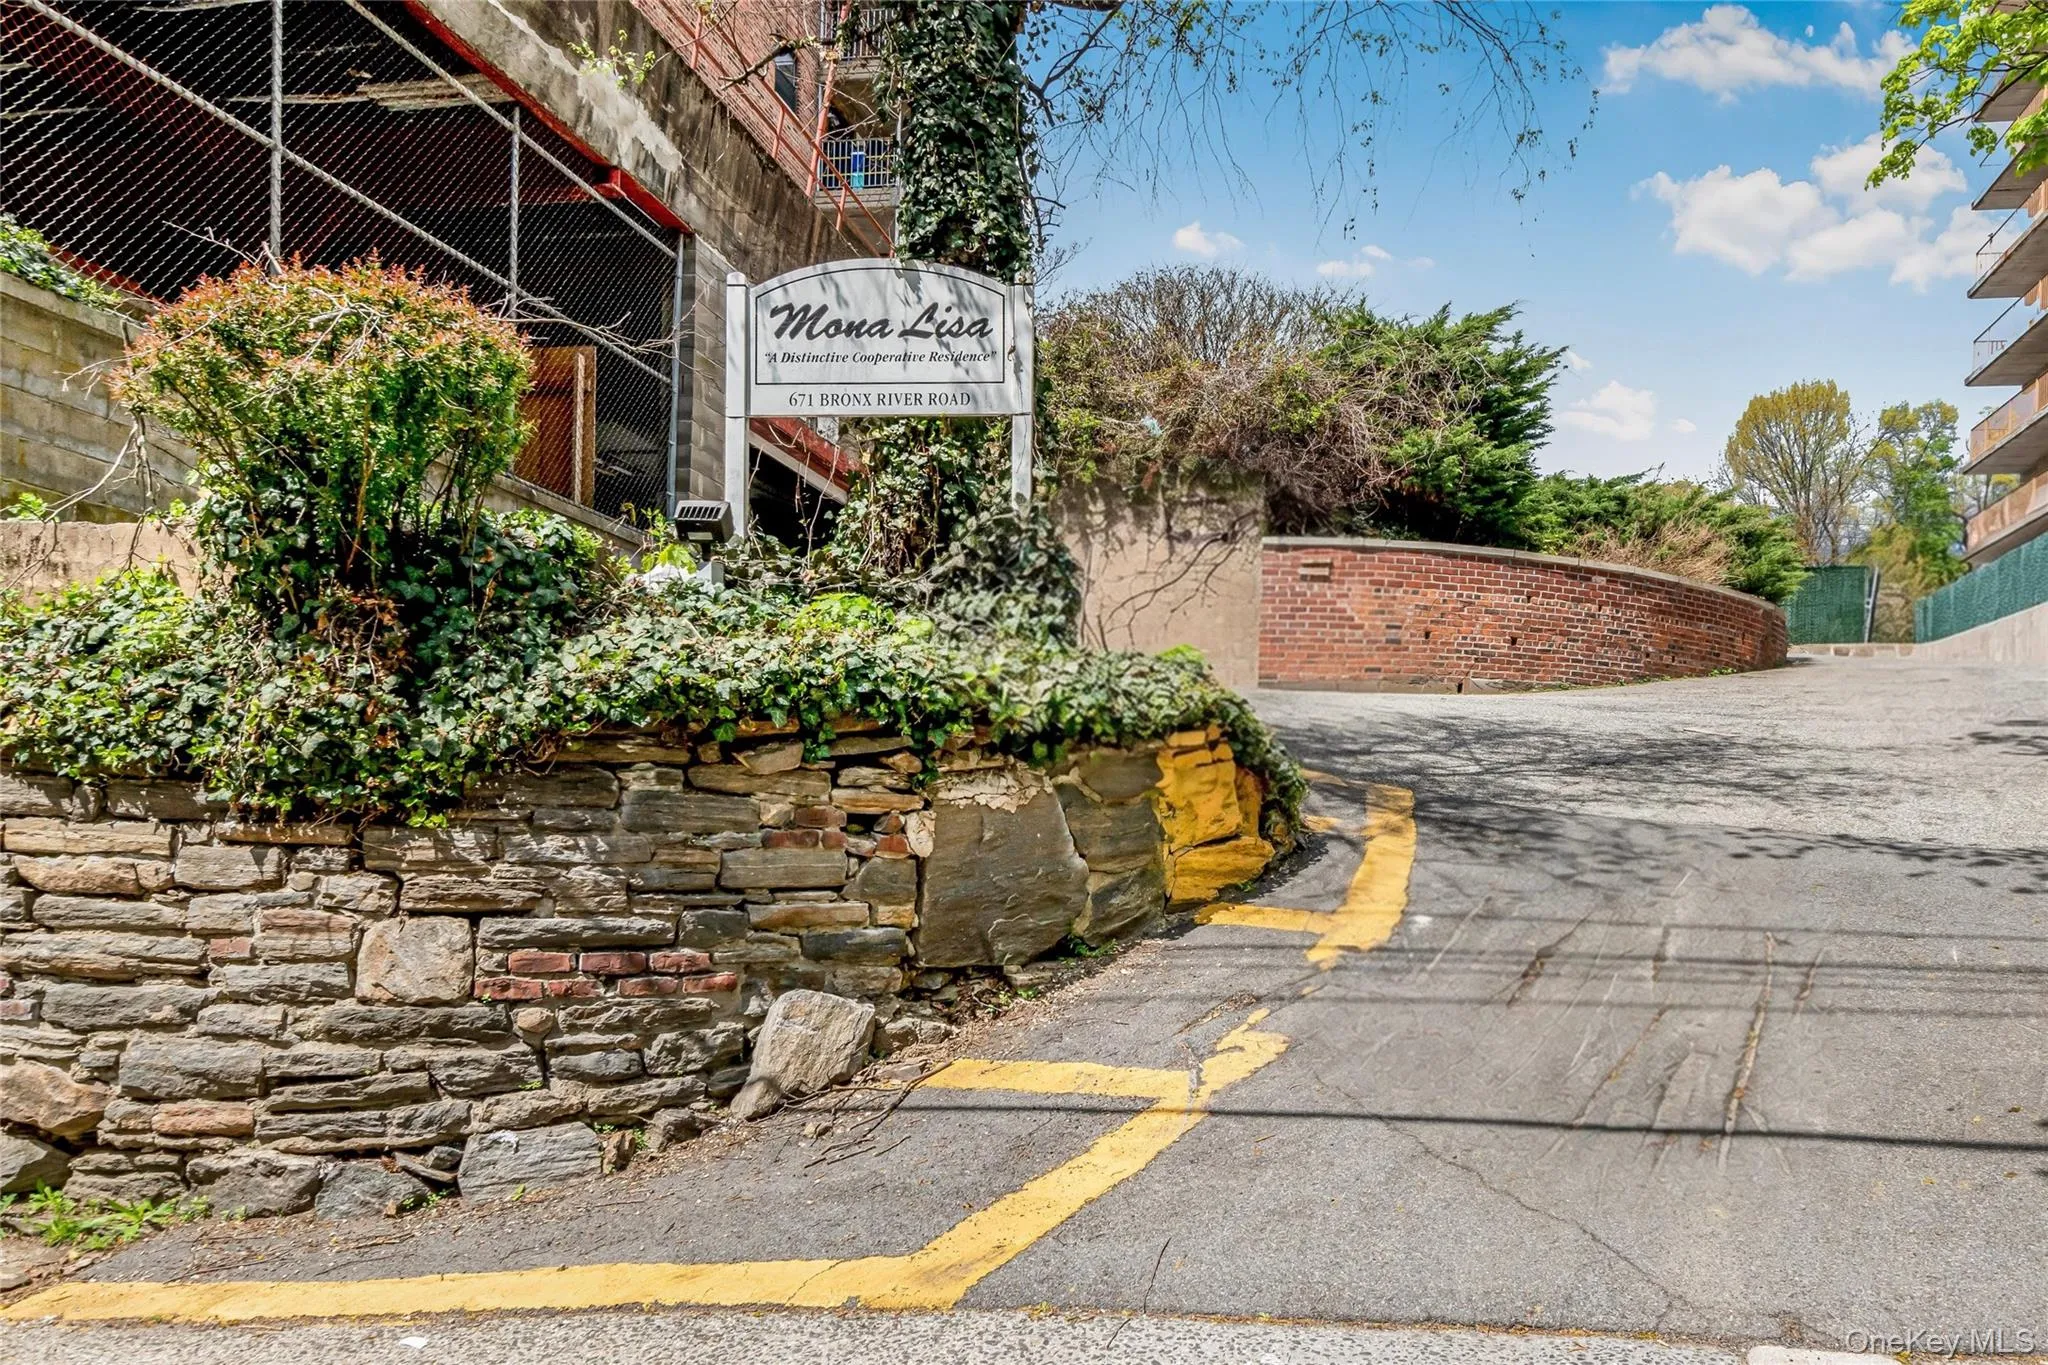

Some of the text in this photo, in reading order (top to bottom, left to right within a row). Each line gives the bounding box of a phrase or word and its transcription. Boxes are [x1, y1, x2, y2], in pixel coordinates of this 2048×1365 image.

[770, 302, 994, 341] Mona Lisa
[780, 351, 849, 363] Distinctive
[852, 351, 926, 365] Cooperative
[789, 392, 971, 407] 671 BRONX RIVER ROAD
